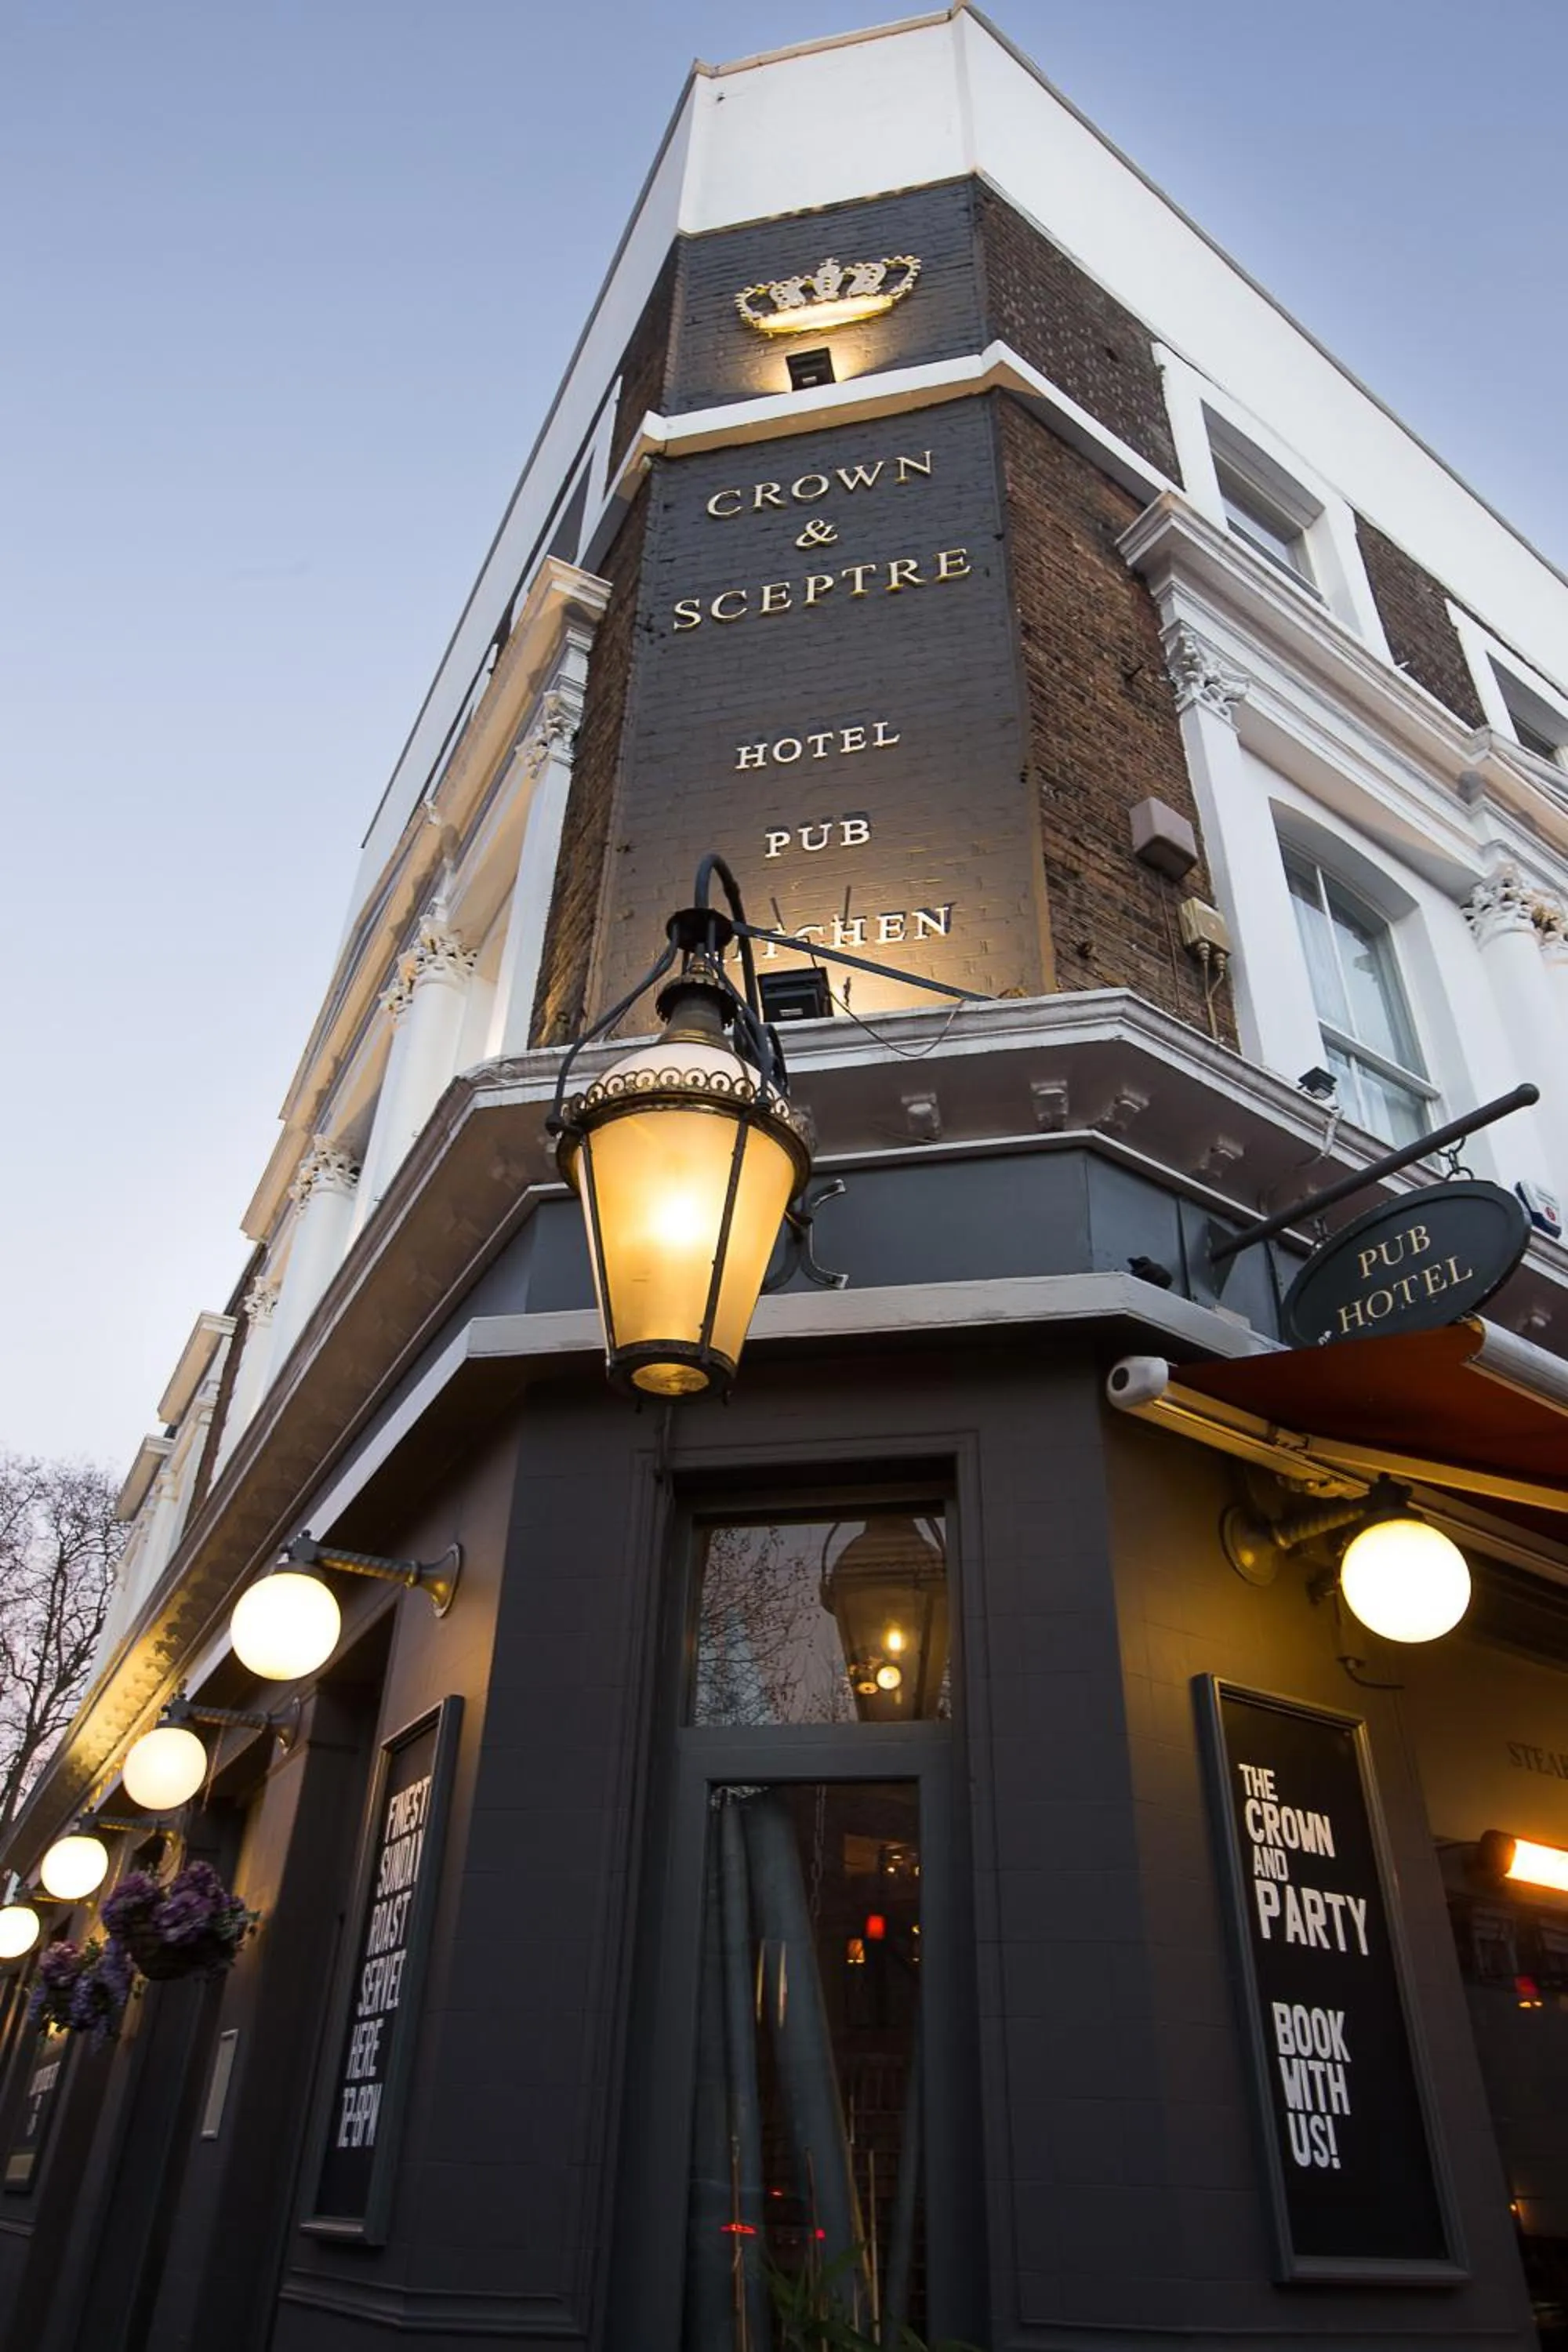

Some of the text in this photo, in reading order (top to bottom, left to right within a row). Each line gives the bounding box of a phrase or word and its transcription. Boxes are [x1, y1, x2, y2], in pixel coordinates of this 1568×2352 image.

[707, 451, 932, 517] CROWN
[795, 518, 838, 549] &
[673, 548, 971, 630] SCEPTRE
[735, 721, 900, 769] HOTEL
[764, 818, 871, 858] PUB
[1358, 1225, 1431, 1279] PUB
[1337, 1256, 1473, 1334] HOTEL
[385, 1775, 432, 1843] FINEST
[1239, 1763, 1279, 1802] THE
[1245, 1798, 1336, 1858] CROWN
[1254, 1845, 1290, 1882] AND
[366, 1890, 412, 1957] ROAST
[1255, 1879, 1369, 1956] PARTY
[346, 2018, 384, 2079] HERE
[1272, 2002, 1352, 2063] BOOK
[1279, 2056, 1351, 2115] WITH
[1287, 2112, 1341, 2169] US!
